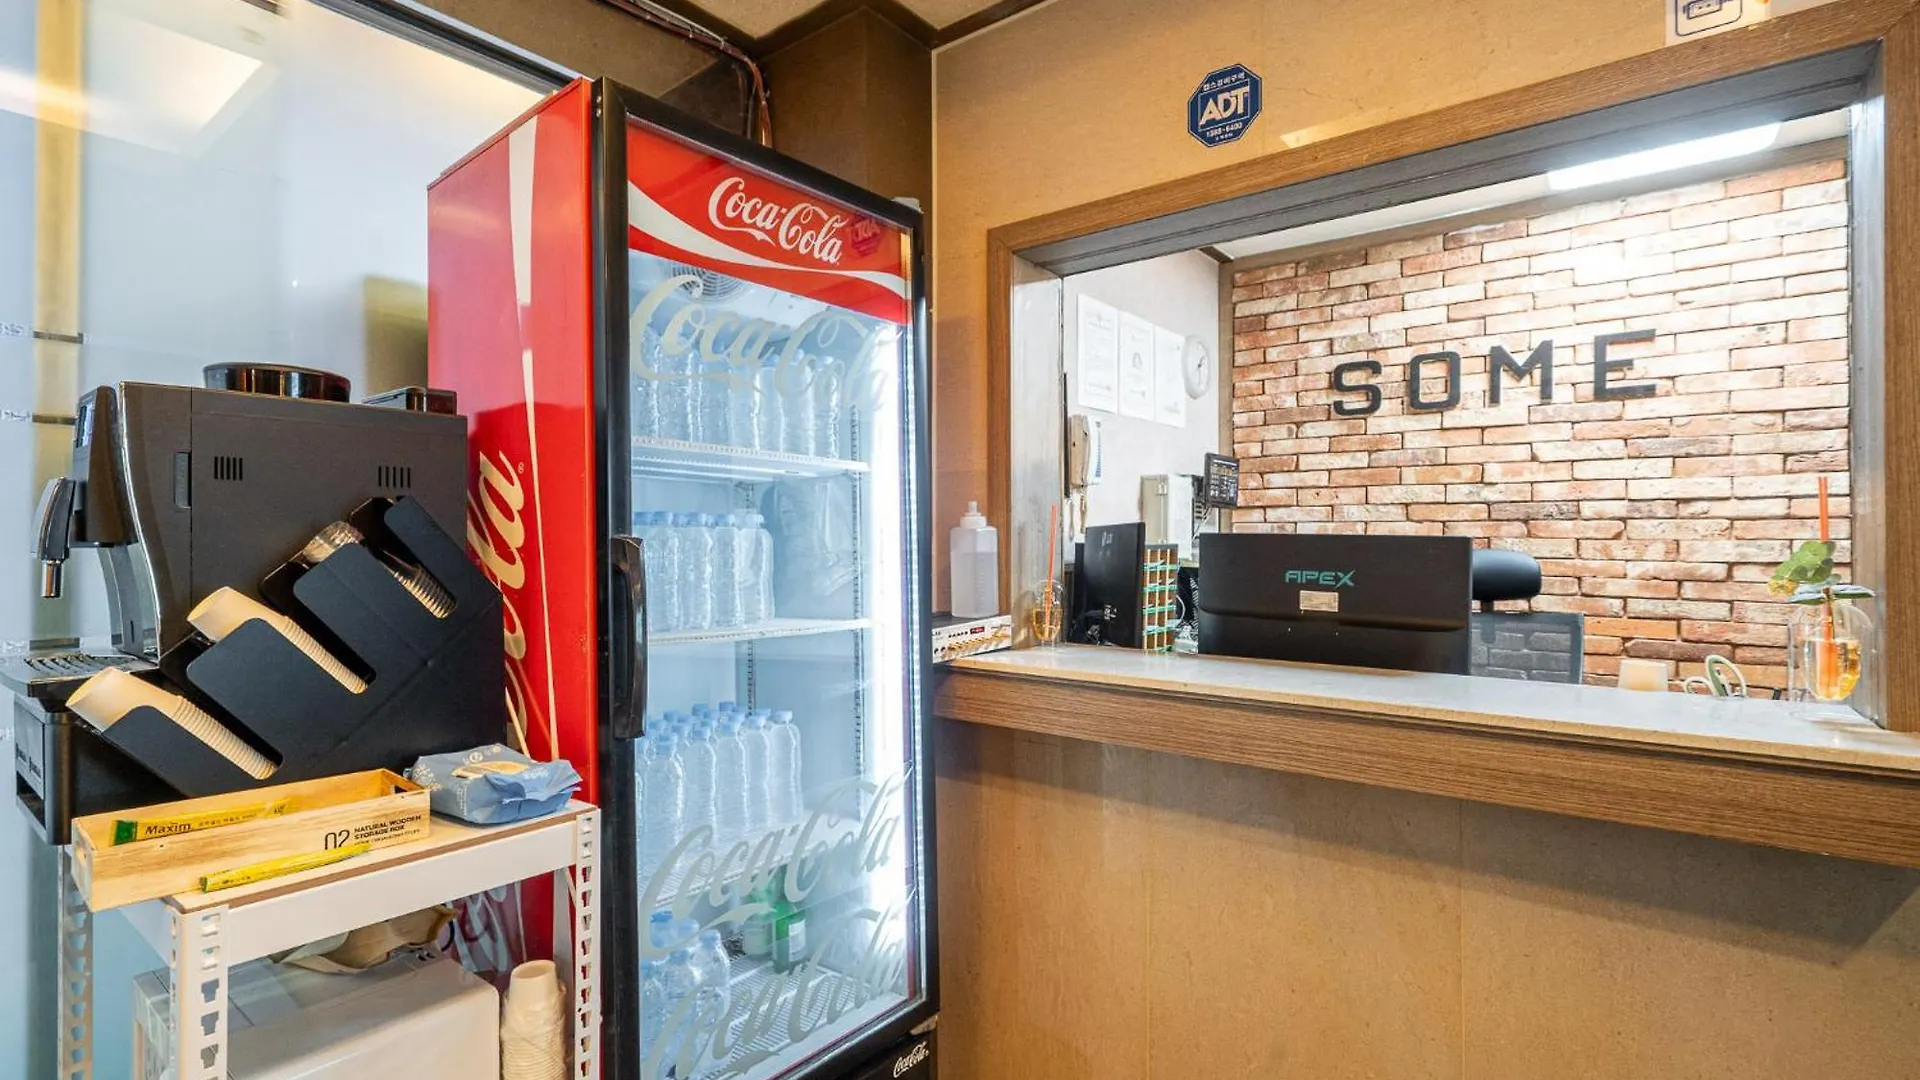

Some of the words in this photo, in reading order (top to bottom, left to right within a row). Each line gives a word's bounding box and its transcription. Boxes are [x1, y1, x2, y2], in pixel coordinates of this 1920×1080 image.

[1199, 85, 1250, 125] ADT
[708, 176, 849, 265] Coca-Cola
[1332, 328, 1657, 416] SOME
[1285, 569, 1357, 589] APEX
[145, 820, 192, 836] Maxim
[354, 822, 387, 833] NATURAL
[325, 829, 350, 849] 02
